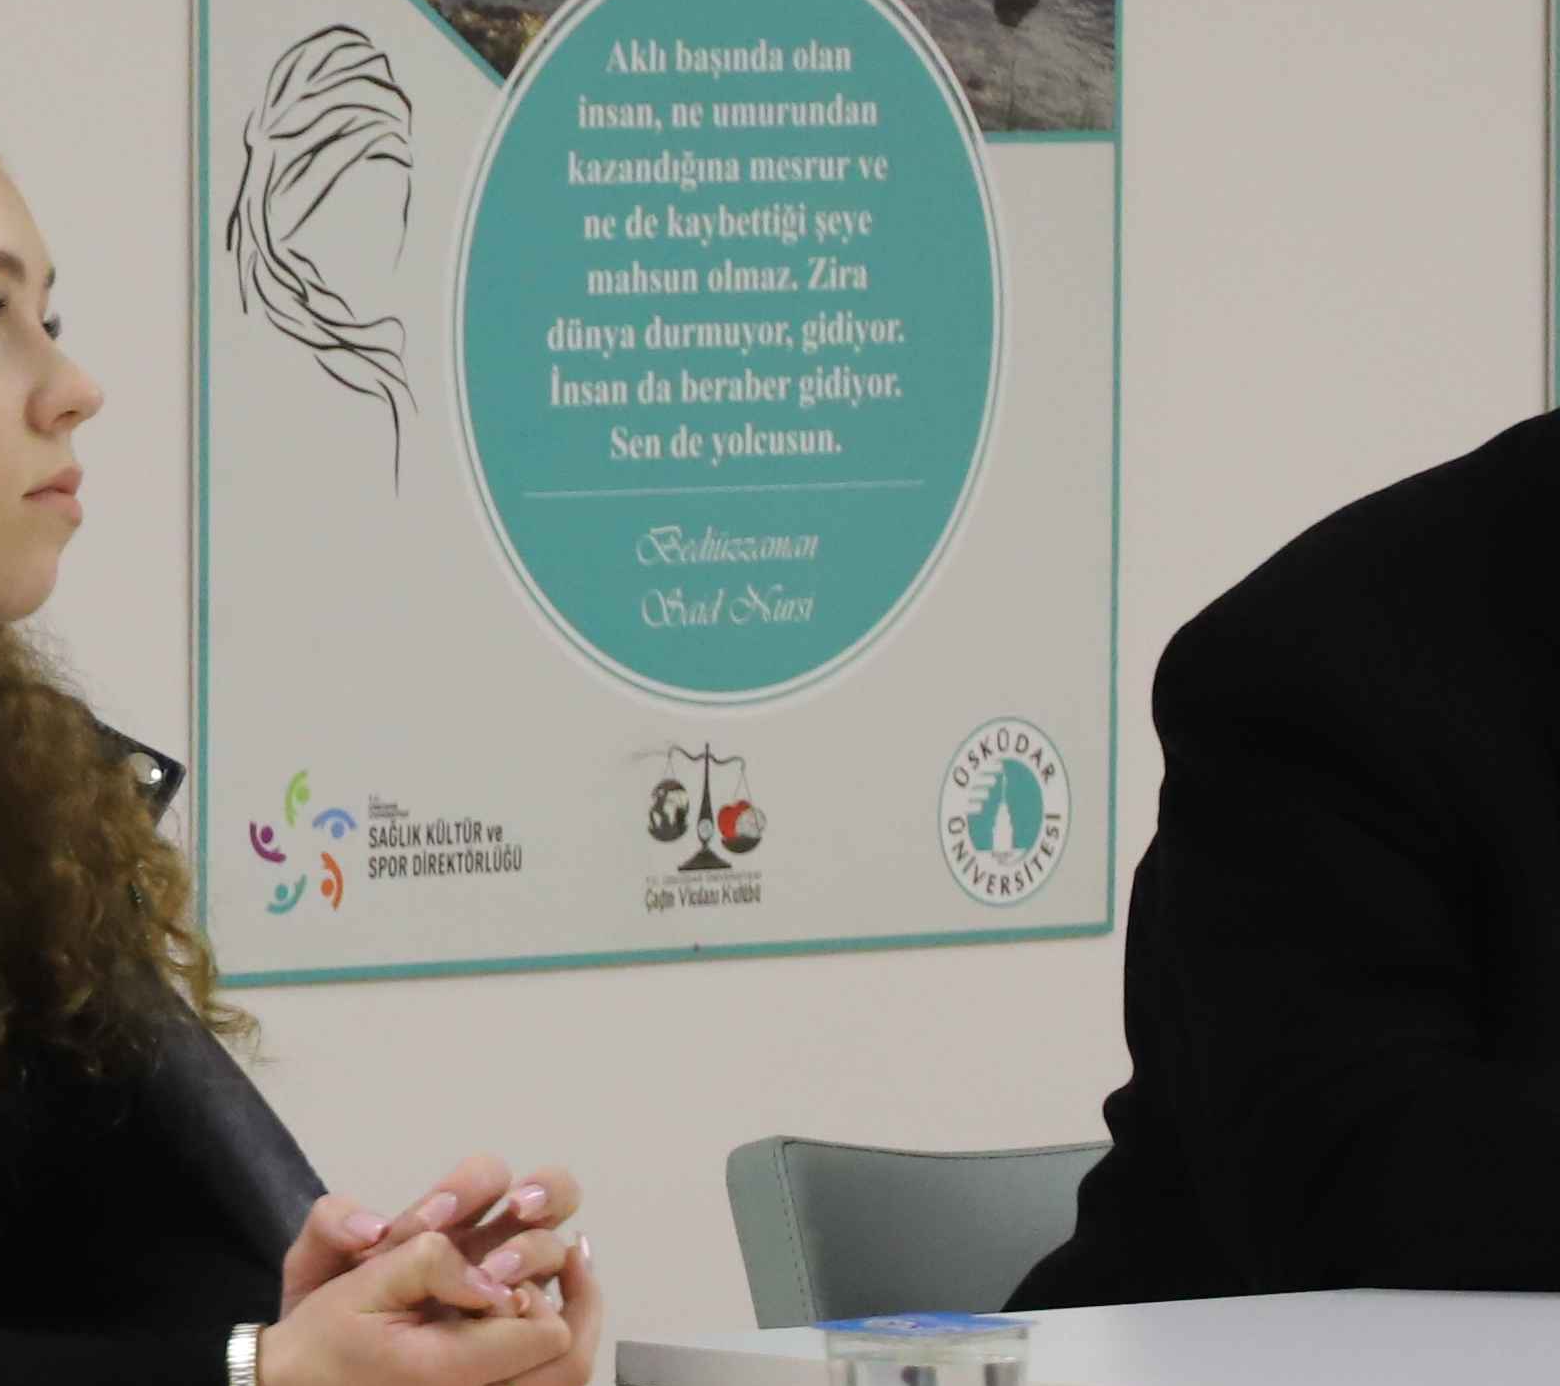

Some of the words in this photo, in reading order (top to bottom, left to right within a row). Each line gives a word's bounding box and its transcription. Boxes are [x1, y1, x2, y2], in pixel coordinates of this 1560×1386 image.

[605, 37, 669, 75] Aklı
[673, 36, 786, 80] başında
[791, 38, 855, 73] olan
[576, 93, 664, 133] insan,
[670, 101, 705, 130] ne
[711, 92, 881, 129] umurundan
[567, 148, 742, 190] kazandığına
[749, 155, 852, 182] mesrur
[857, 154, 889, 182] ve
[583, 213, 617, 242] ne
[624, 204, 660, 241] de
[666, 203, 809, 247] kaybettiği
[814, 209, 873, 245] şeye
[585, 260, 700, 297] mahsun
[706, 259, 800, 294] olmaz.
[807, 256, 872, 292] Zira
[545, 316, 637, 359] dünya
[643, 314, 795, 356] durmuyor,
[801, 310, 905, 353] gidiyor.
[548, 362, 629, 408] İnsan
[636, 370, 673, 406] da
[680, 367, 792, 405] beraber
[798, 366, 905, 409] gidiyor.
[609, 425, 664, 461] Sen
[668, 424, 705, 461] de
[710, 421, 844, 469] yolcusun.
[952, 727, 1056, 789] ÜSKÜDAR
[369, 819, 421, 849] SAĞLIK
[426, 817, 482, 846] KÜLTÜR
[486, 824, 503, 843] ve
[369, 855, 408, 880] SPOR
[412, 843, 523, 877] DİREKTÖRLÜĞÜ
